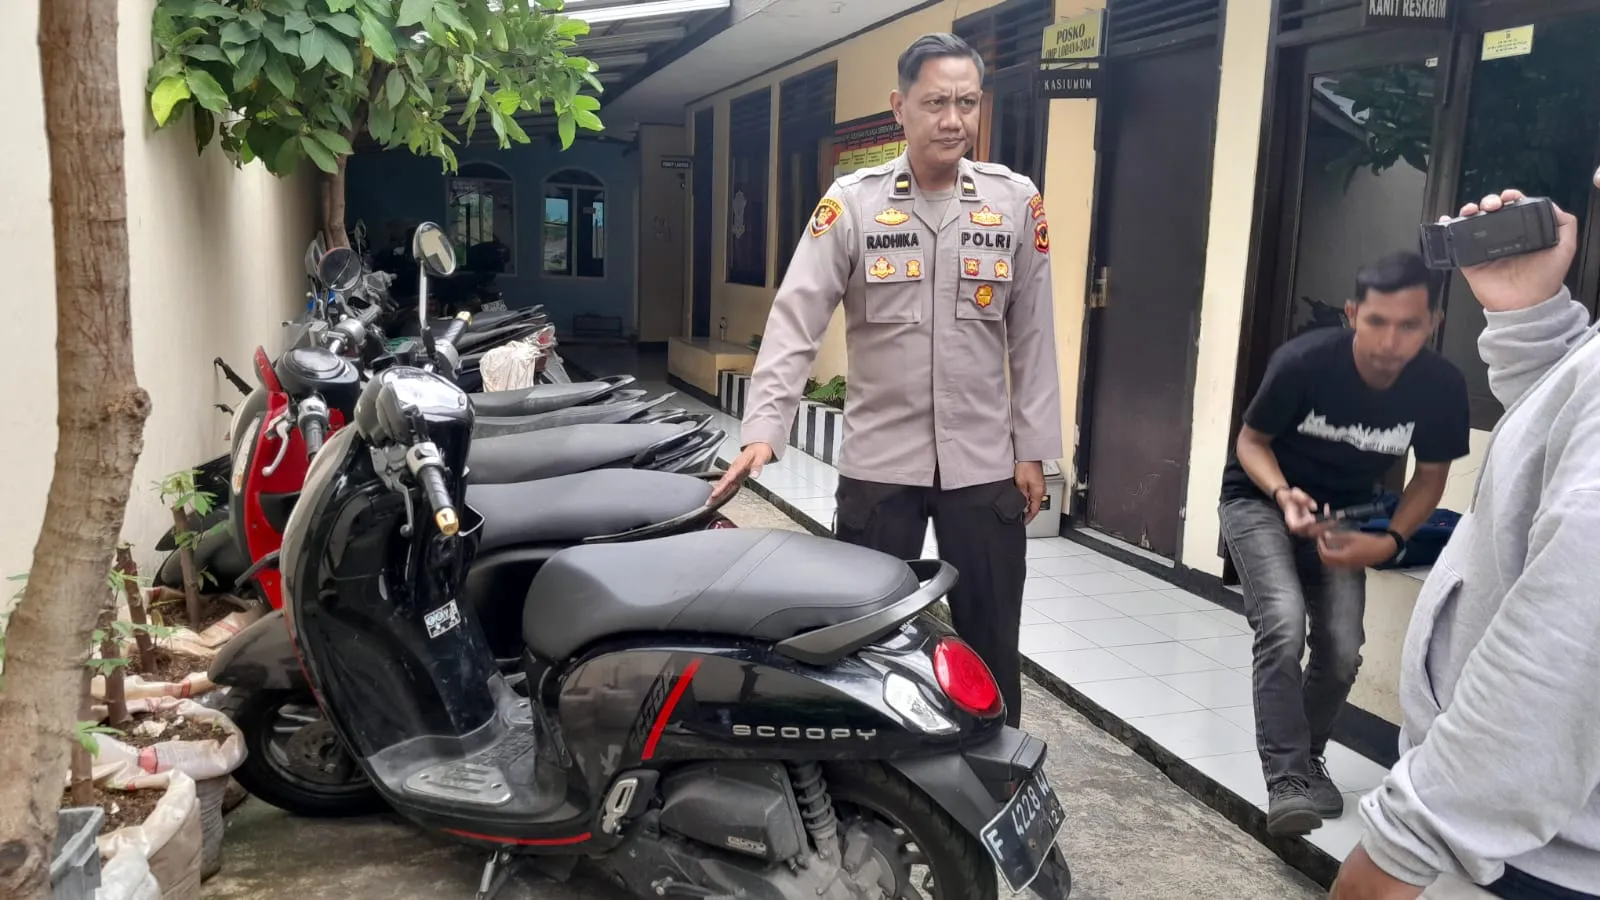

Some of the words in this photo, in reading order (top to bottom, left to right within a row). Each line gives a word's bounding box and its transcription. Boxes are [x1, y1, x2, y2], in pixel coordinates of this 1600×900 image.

[1369, 0, 1399, 16] KANIT
[1402, 0, 1447, 18] RESKRIM
[1056, 23, 1085, 44] POSKO
[866, 232, 919, 249] RADHIKA
[961, 231, 1011, 249] POLRI
[732, 724, 876, 740] SCOOPY
[986, 828, 1004, 860] F
[1011, 785, 1041, 836] 4228
